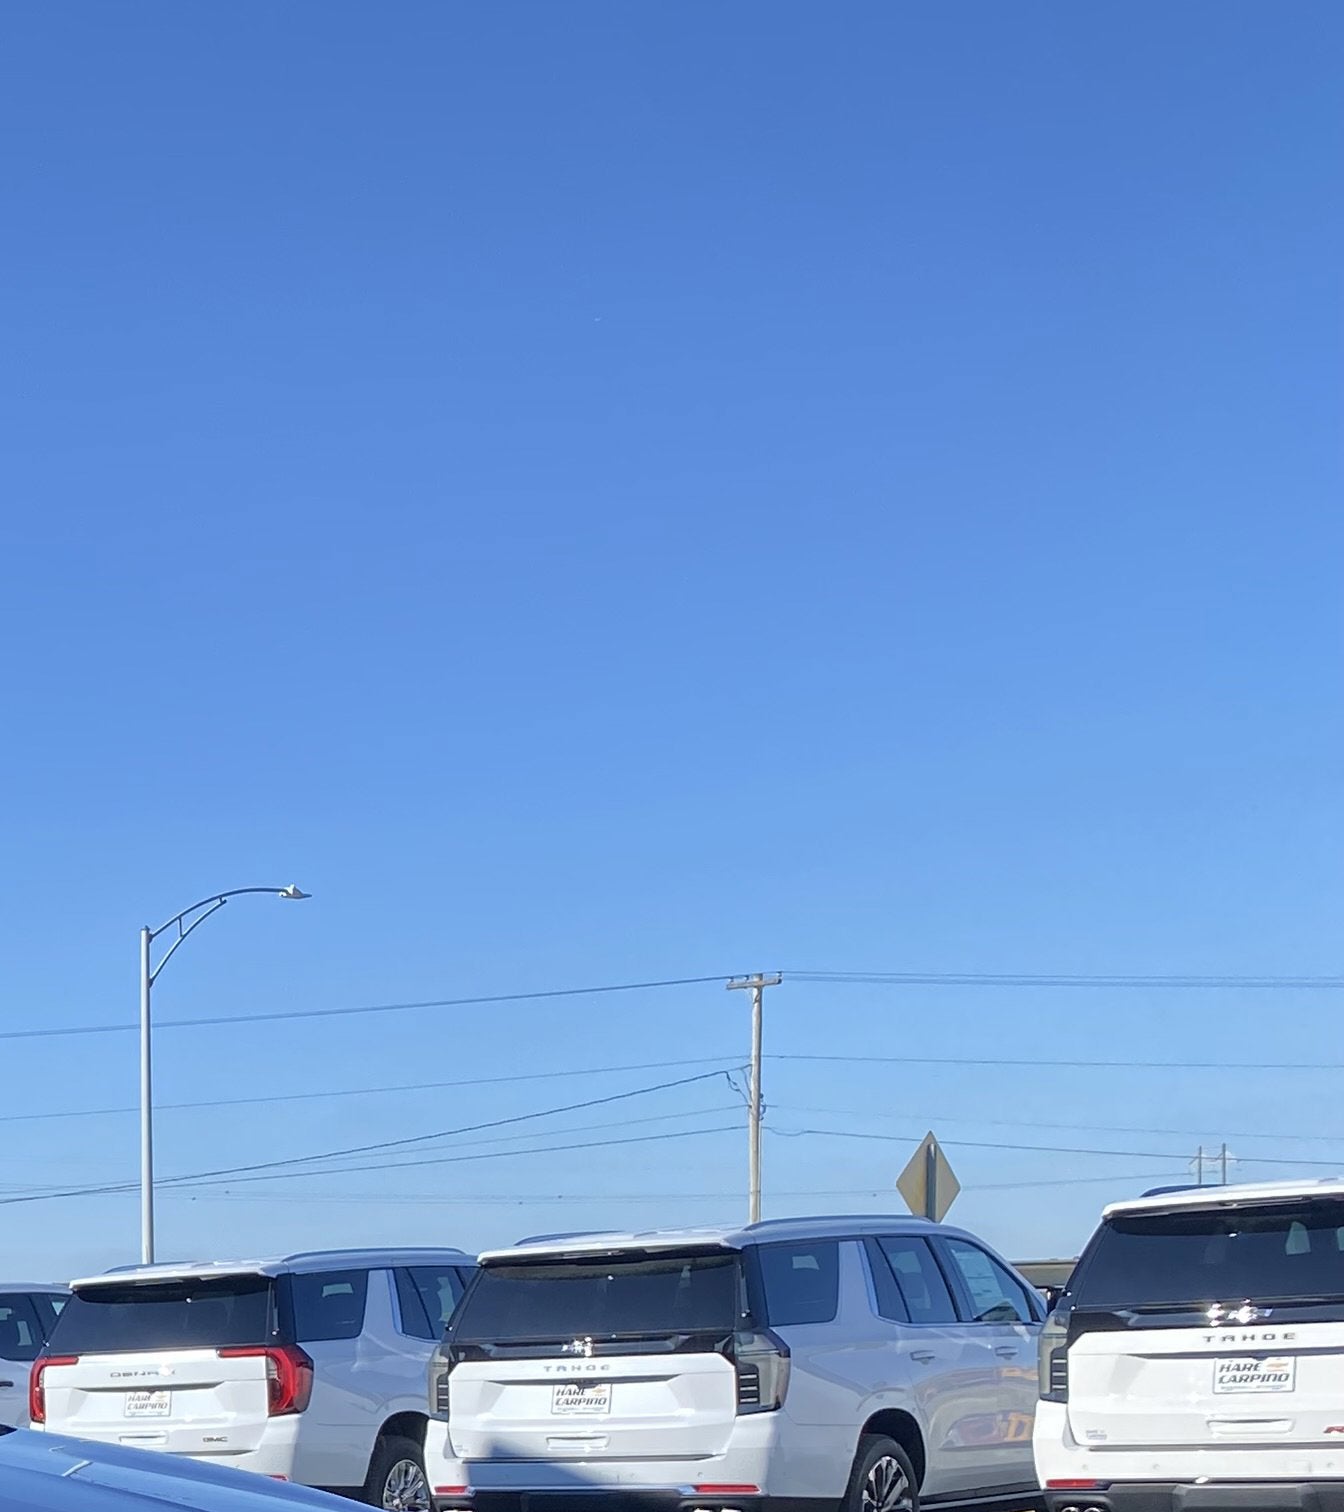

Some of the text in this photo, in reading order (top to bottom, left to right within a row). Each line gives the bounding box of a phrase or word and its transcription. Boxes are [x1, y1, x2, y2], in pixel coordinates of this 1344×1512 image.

[1202, 1332, 1296, 1343] TAHOE
[543, 1364, 611, 1372] TAHOE
[1219, 1361, 1262, 1373] HARE
[1218, 1373, 1290, 1384] CARPINO
